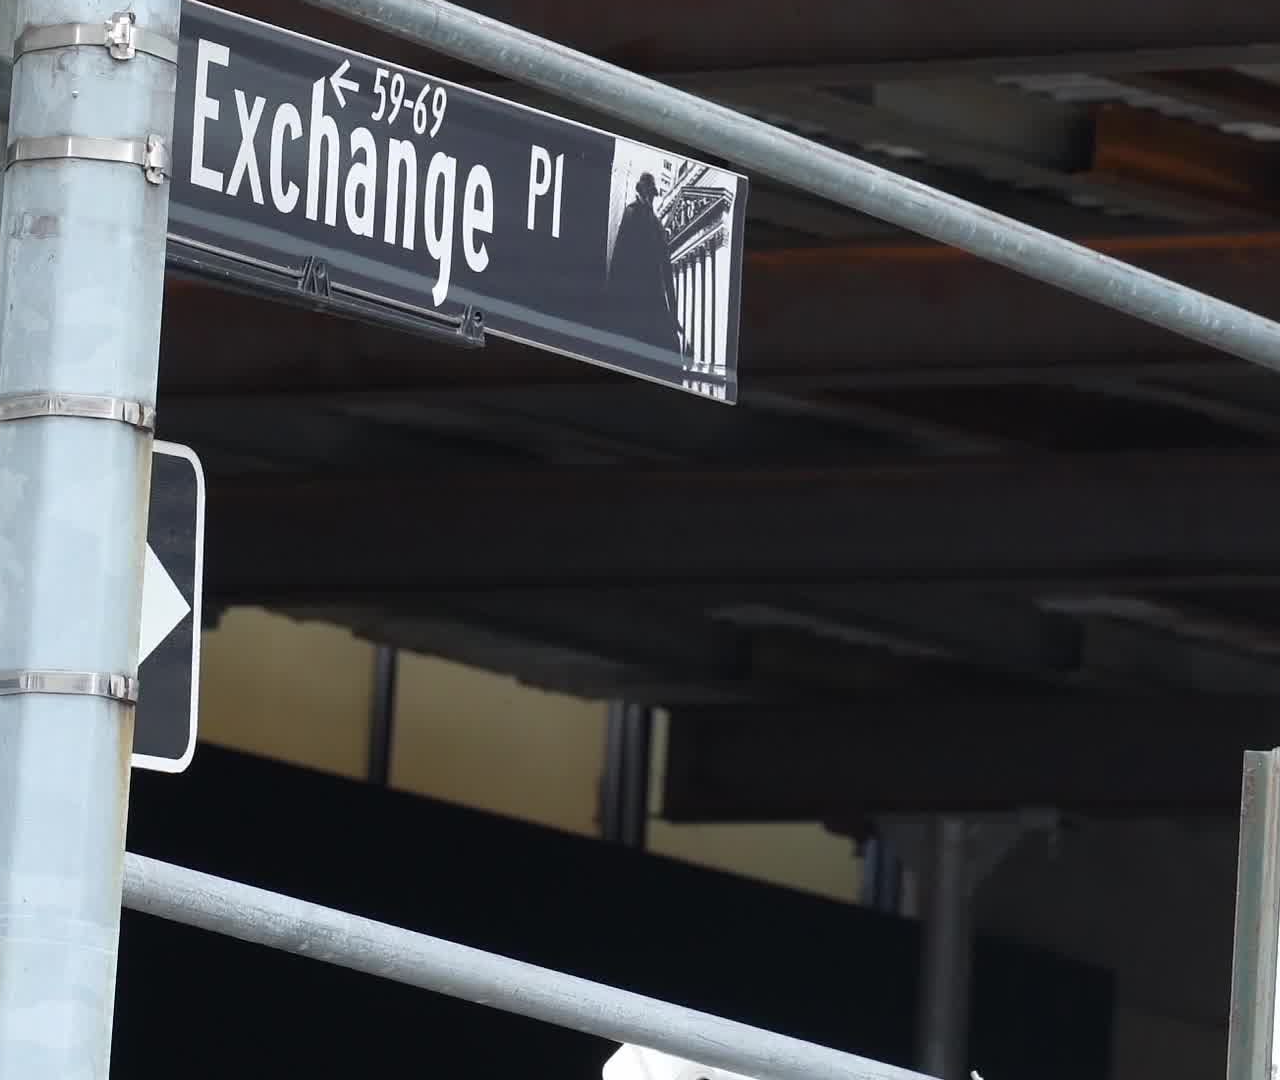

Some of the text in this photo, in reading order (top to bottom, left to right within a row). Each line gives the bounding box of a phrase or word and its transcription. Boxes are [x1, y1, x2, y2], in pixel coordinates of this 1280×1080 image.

[190, 38, 565, 307] Exchange Pl
[371, 67, 447, 139] 59-69
